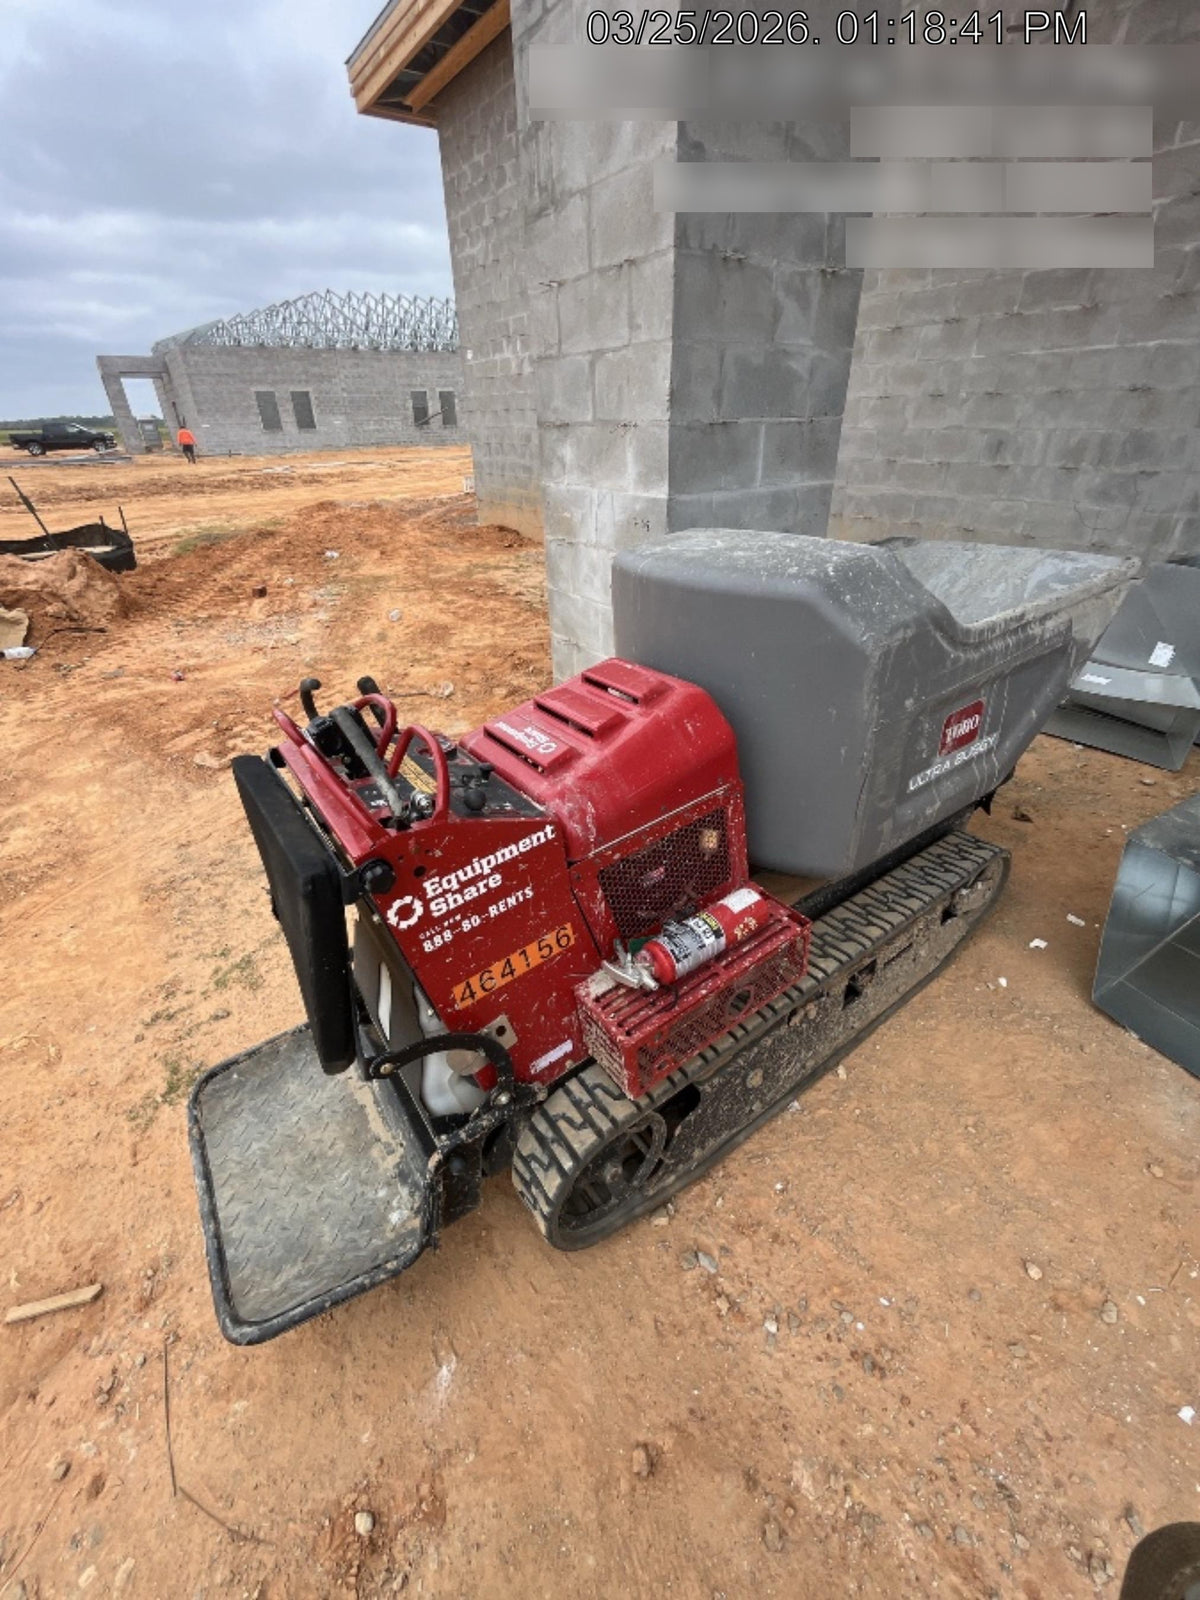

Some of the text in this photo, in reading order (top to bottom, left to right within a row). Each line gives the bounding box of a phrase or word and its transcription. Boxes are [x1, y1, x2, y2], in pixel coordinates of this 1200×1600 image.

[907, 760, 950, 792] ULTRA
[422, 824, 556, 899] Equipment
[429, 873, 502, 917] Share
[460, 927, 572, 1005] 464156
